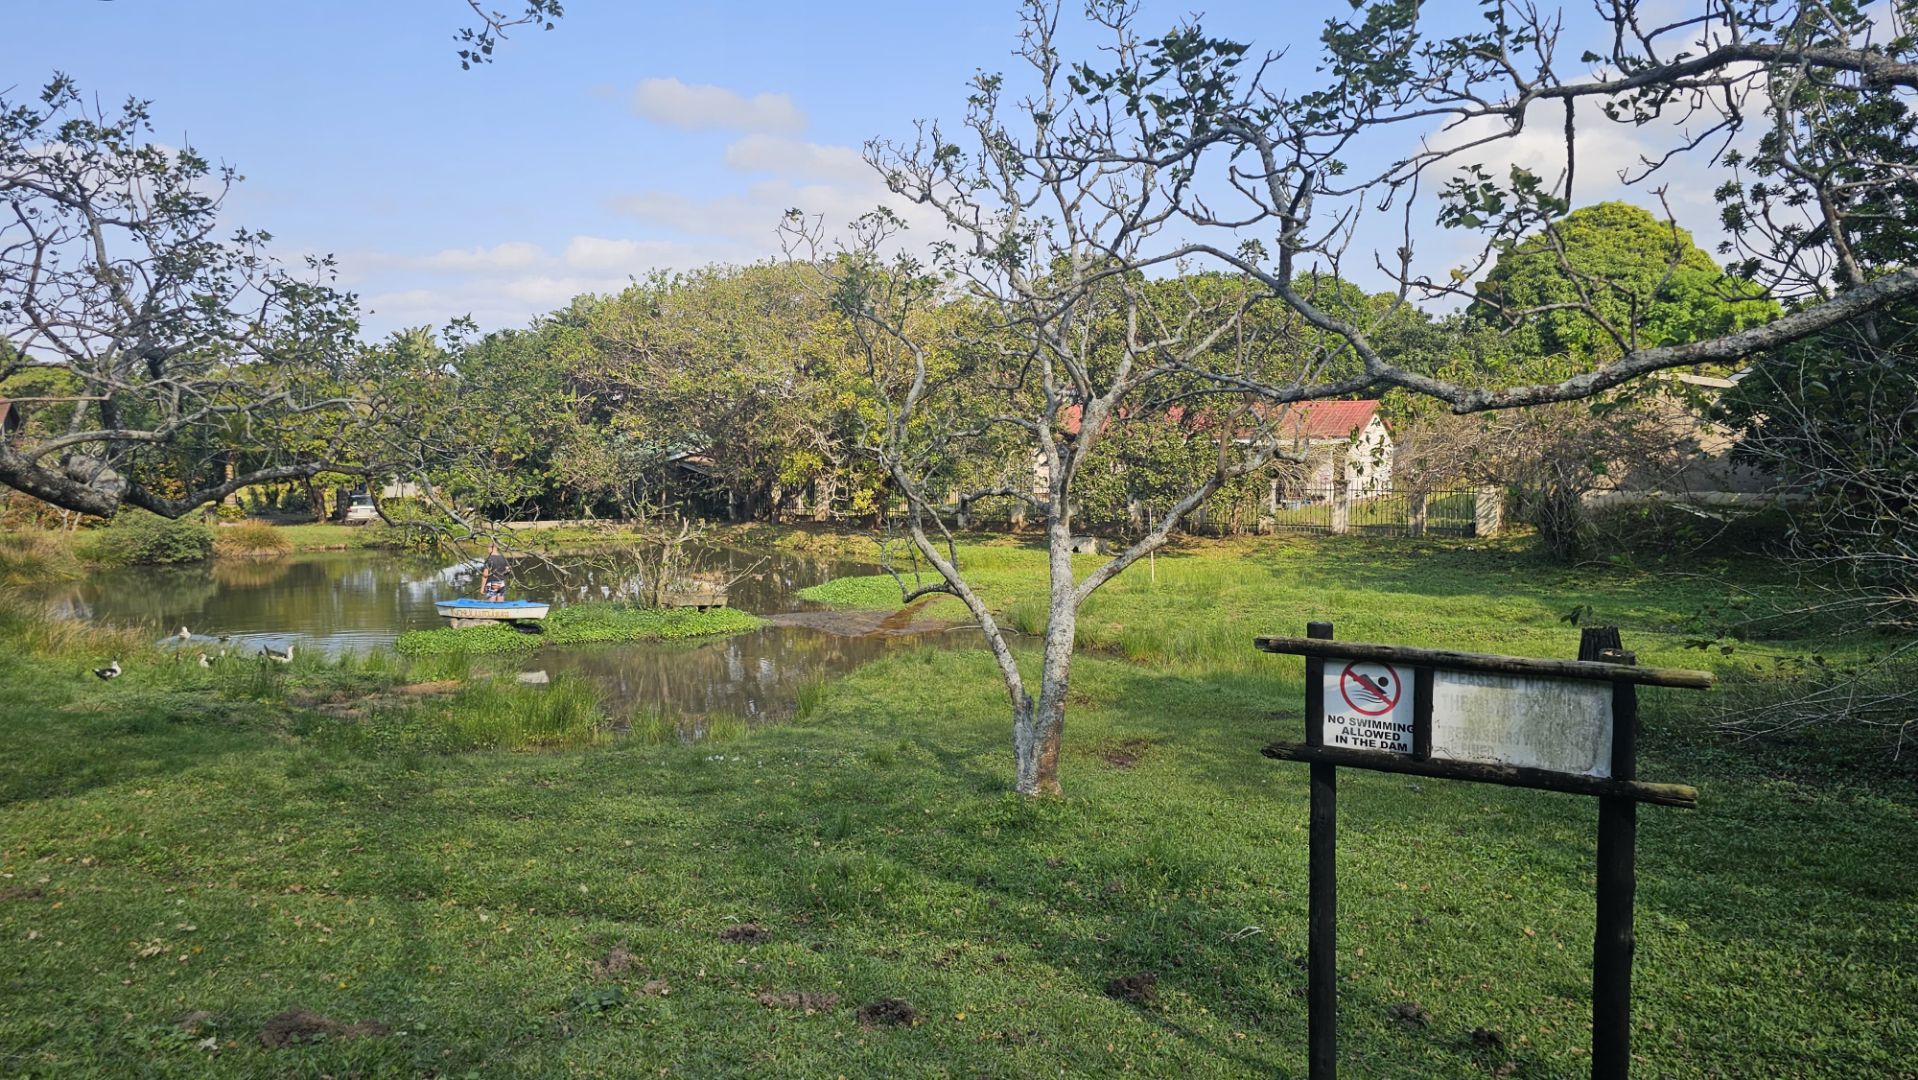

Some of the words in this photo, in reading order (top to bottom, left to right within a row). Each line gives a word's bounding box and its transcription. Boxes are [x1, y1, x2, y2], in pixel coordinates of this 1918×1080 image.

[1441, 672, 1497, 688] PLEASE
[1441, 693, 1470, 712] THE
[1328, 715, 1344, 724] NO
[1349, 718, 1415, 733] SWIMMING
[1342, 727, 1400, 741] ALLOWED
[1441, 725, 1521, 746] TRESPASSERS
[1335, 735, 1347, 744] IN
[1352, 738, 1376, 748] THE
[1381, 741, 1407, 751] DAM
